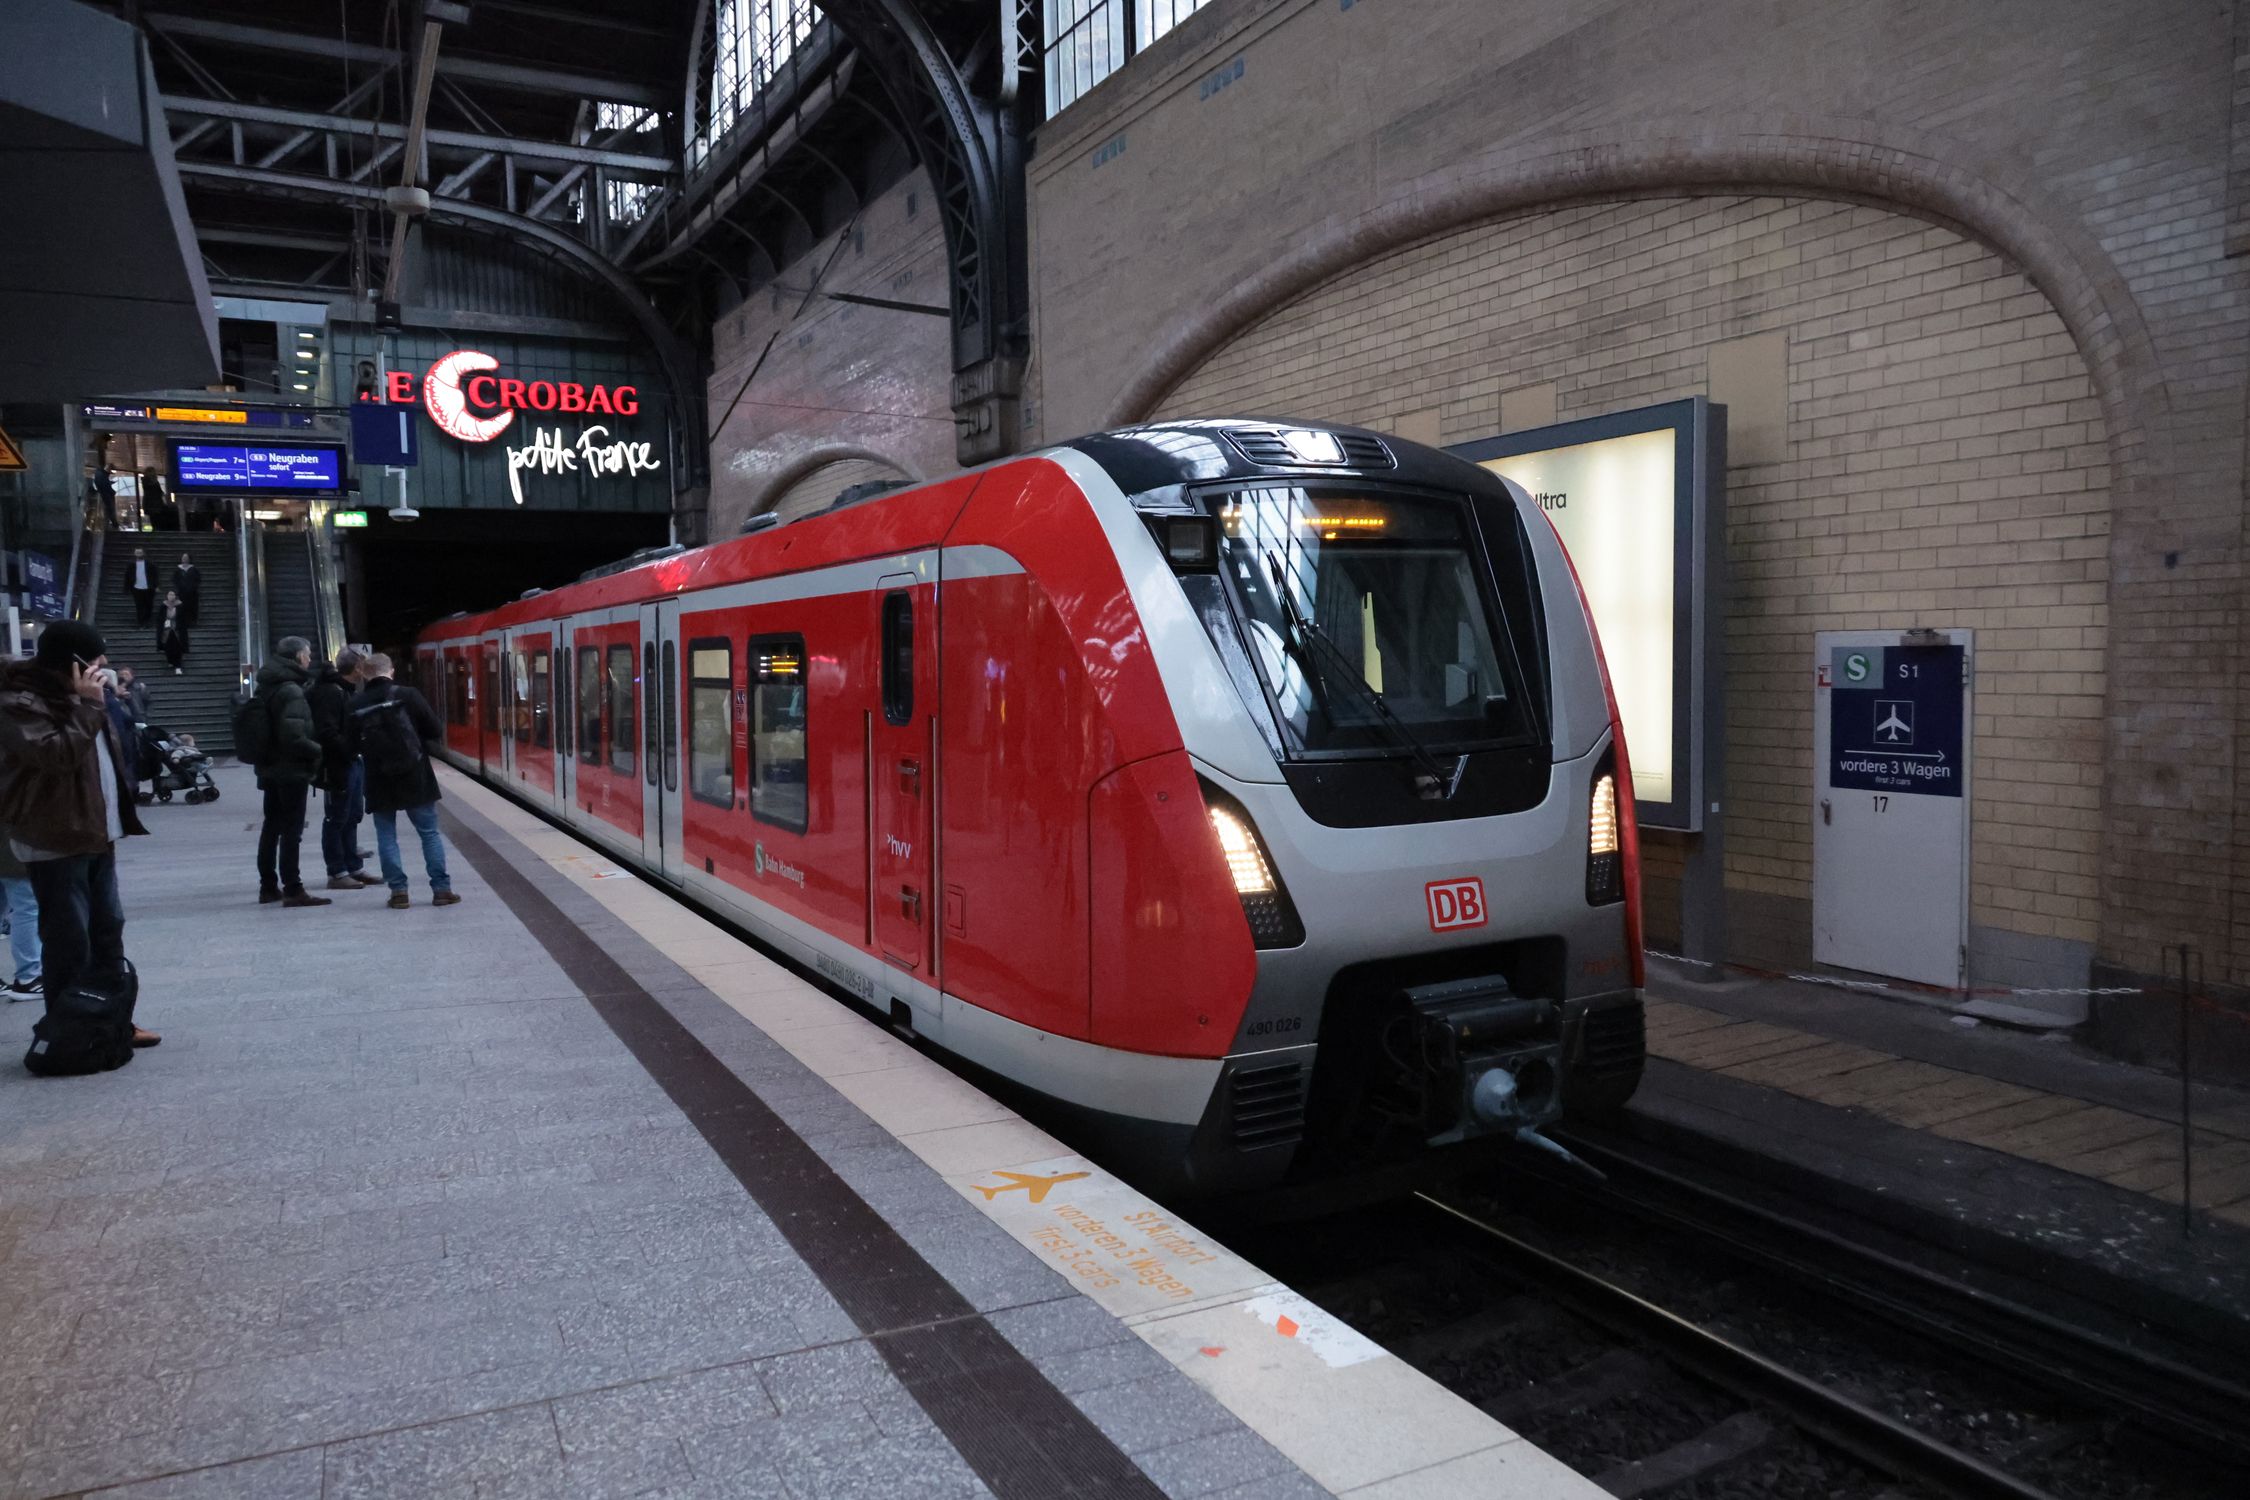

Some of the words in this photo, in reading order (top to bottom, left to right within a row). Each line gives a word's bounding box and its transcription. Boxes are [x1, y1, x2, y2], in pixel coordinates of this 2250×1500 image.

[467, 375, 640, 416] CROBAG
[269, 453, 319, 465] Neugraben
[576, 425, 661, 478] France
[196, 473, 231, 481] Neugraben
[269, 463, 290, 471] sofort
[1840, 759, 1887, 773] vordere
[1891, 761, 1899, 774] 3
[1903, 761, 1950, 779] Wagen
[1873, 796, 1888, 813] 17
[889, 835, 912, 859] hvv
[765, 853, 779, 875] Bahn
[779, 859, 805, 889] Hamburg
[1433, 886, 1480, 924] DB
[1247, 1021, 1272, 1035] 490
[1276, 1017, 1301, 1032] 026
[1053, 1204, 1127, 1251] vorderen
[1127, 1256, 1194, 1298] Wagen
[1071, 1260, 1121, 1289] cars
